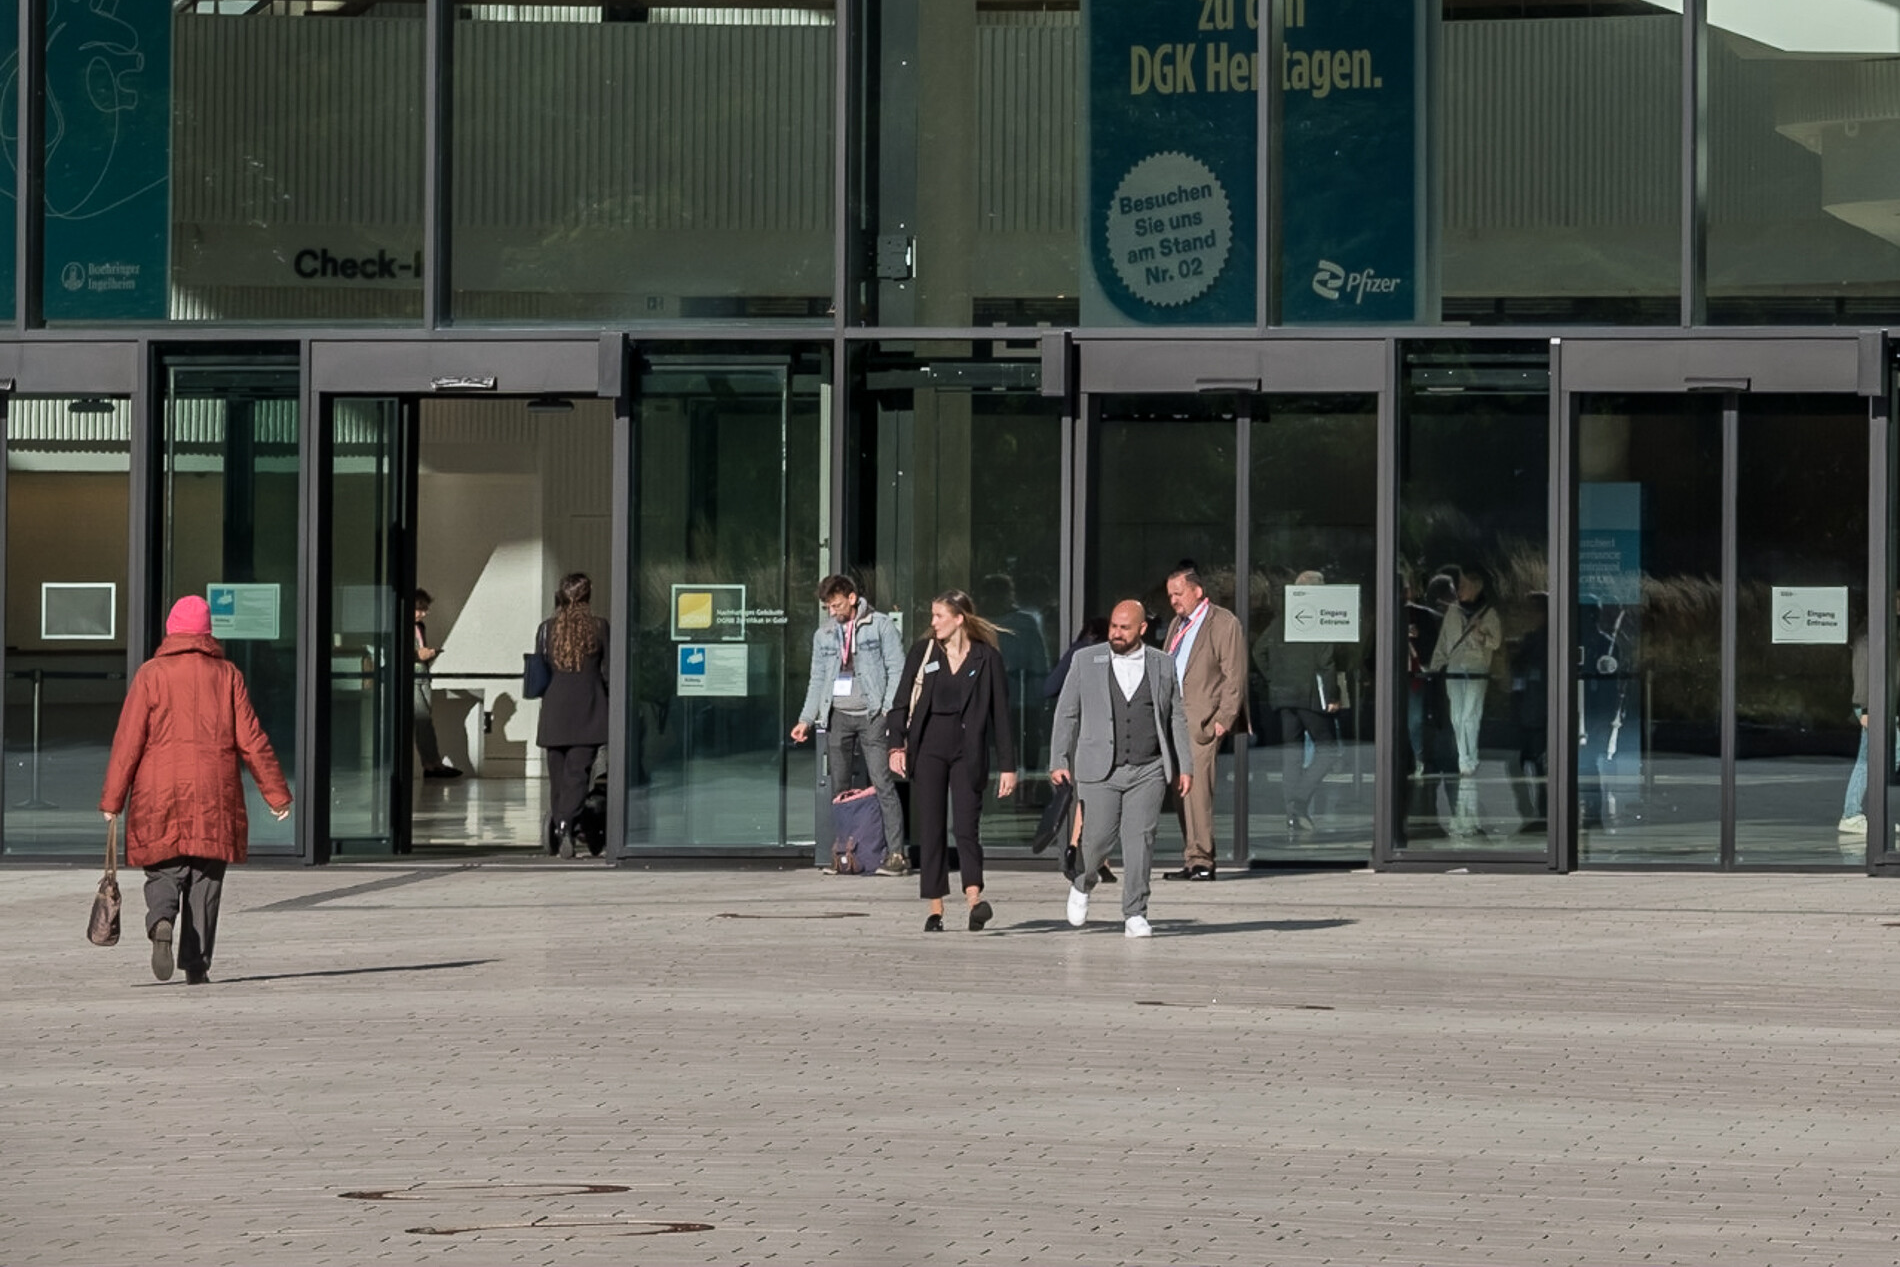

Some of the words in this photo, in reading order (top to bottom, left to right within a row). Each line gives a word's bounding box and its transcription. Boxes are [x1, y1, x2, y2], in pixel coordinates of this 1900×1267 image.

[1130, 43, 1197, 96] DGK
[1206, 40, 1384, 100] Hertagen.
[1120, 183, 1213, 215] Besuchen
[1135, 217, 1165, 237] Sie
[1169, 211, 1203, 231] uns
[1127, 246, 1156, 265] am
[1159, 228, 1217, 257] Stand
[87, 262, 141, 277] Boehringer
[294, 248, 422, 280] Check-I
[1145, 265, 1174, 286] Nr.
[1178, 256, 1204, 279] 02
[87, 277, 136, 293] Ingelheim
[1346, 268, 1400, 305] Pfizer
[1319, 609, 1348, 618] Eingang
[1319, 618, 1351, 626] Entrance
[1806, 610, 1835, 619] Eingang
[1806, 619, 1838, 627] Entrance
